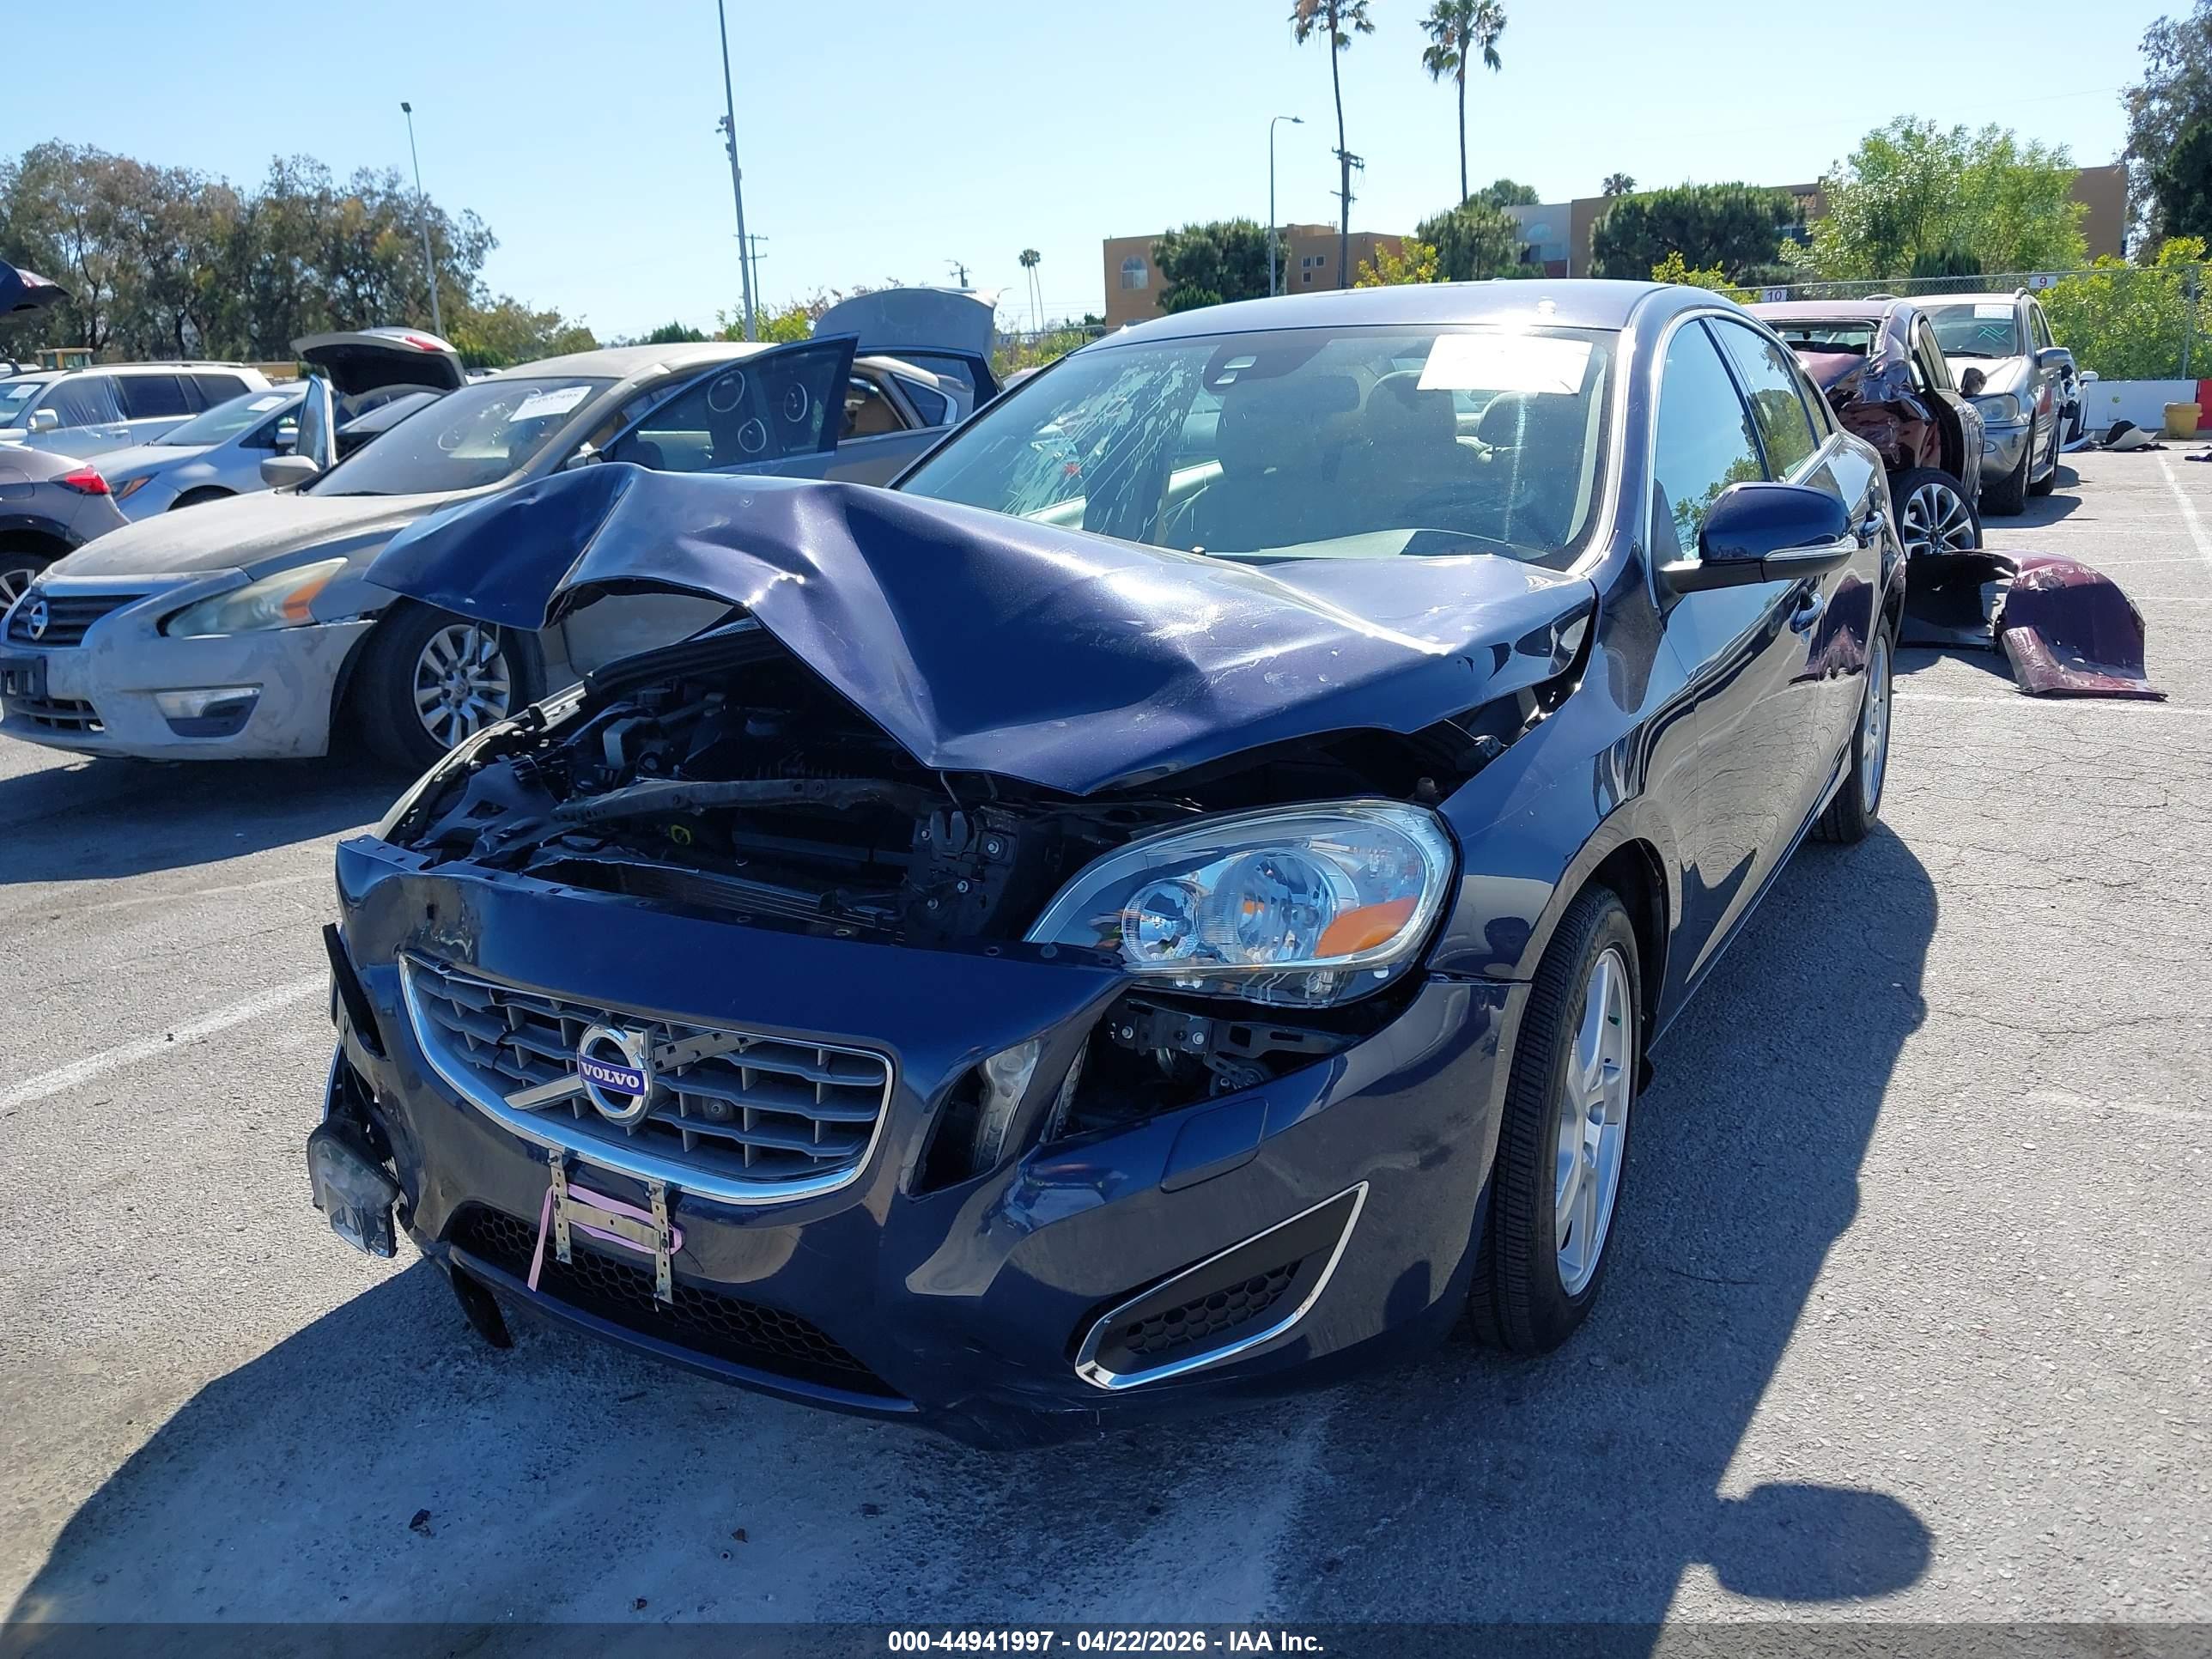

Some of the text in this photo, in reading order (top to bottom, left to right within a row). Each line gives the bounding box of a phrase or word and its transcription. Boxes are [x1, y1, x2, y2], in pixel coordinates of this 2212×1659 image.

[2039, 276, 2048, 288] 9
[1766, 290, 1783, 302] 10
[580, 1061, 640, 1089] VOLVO
